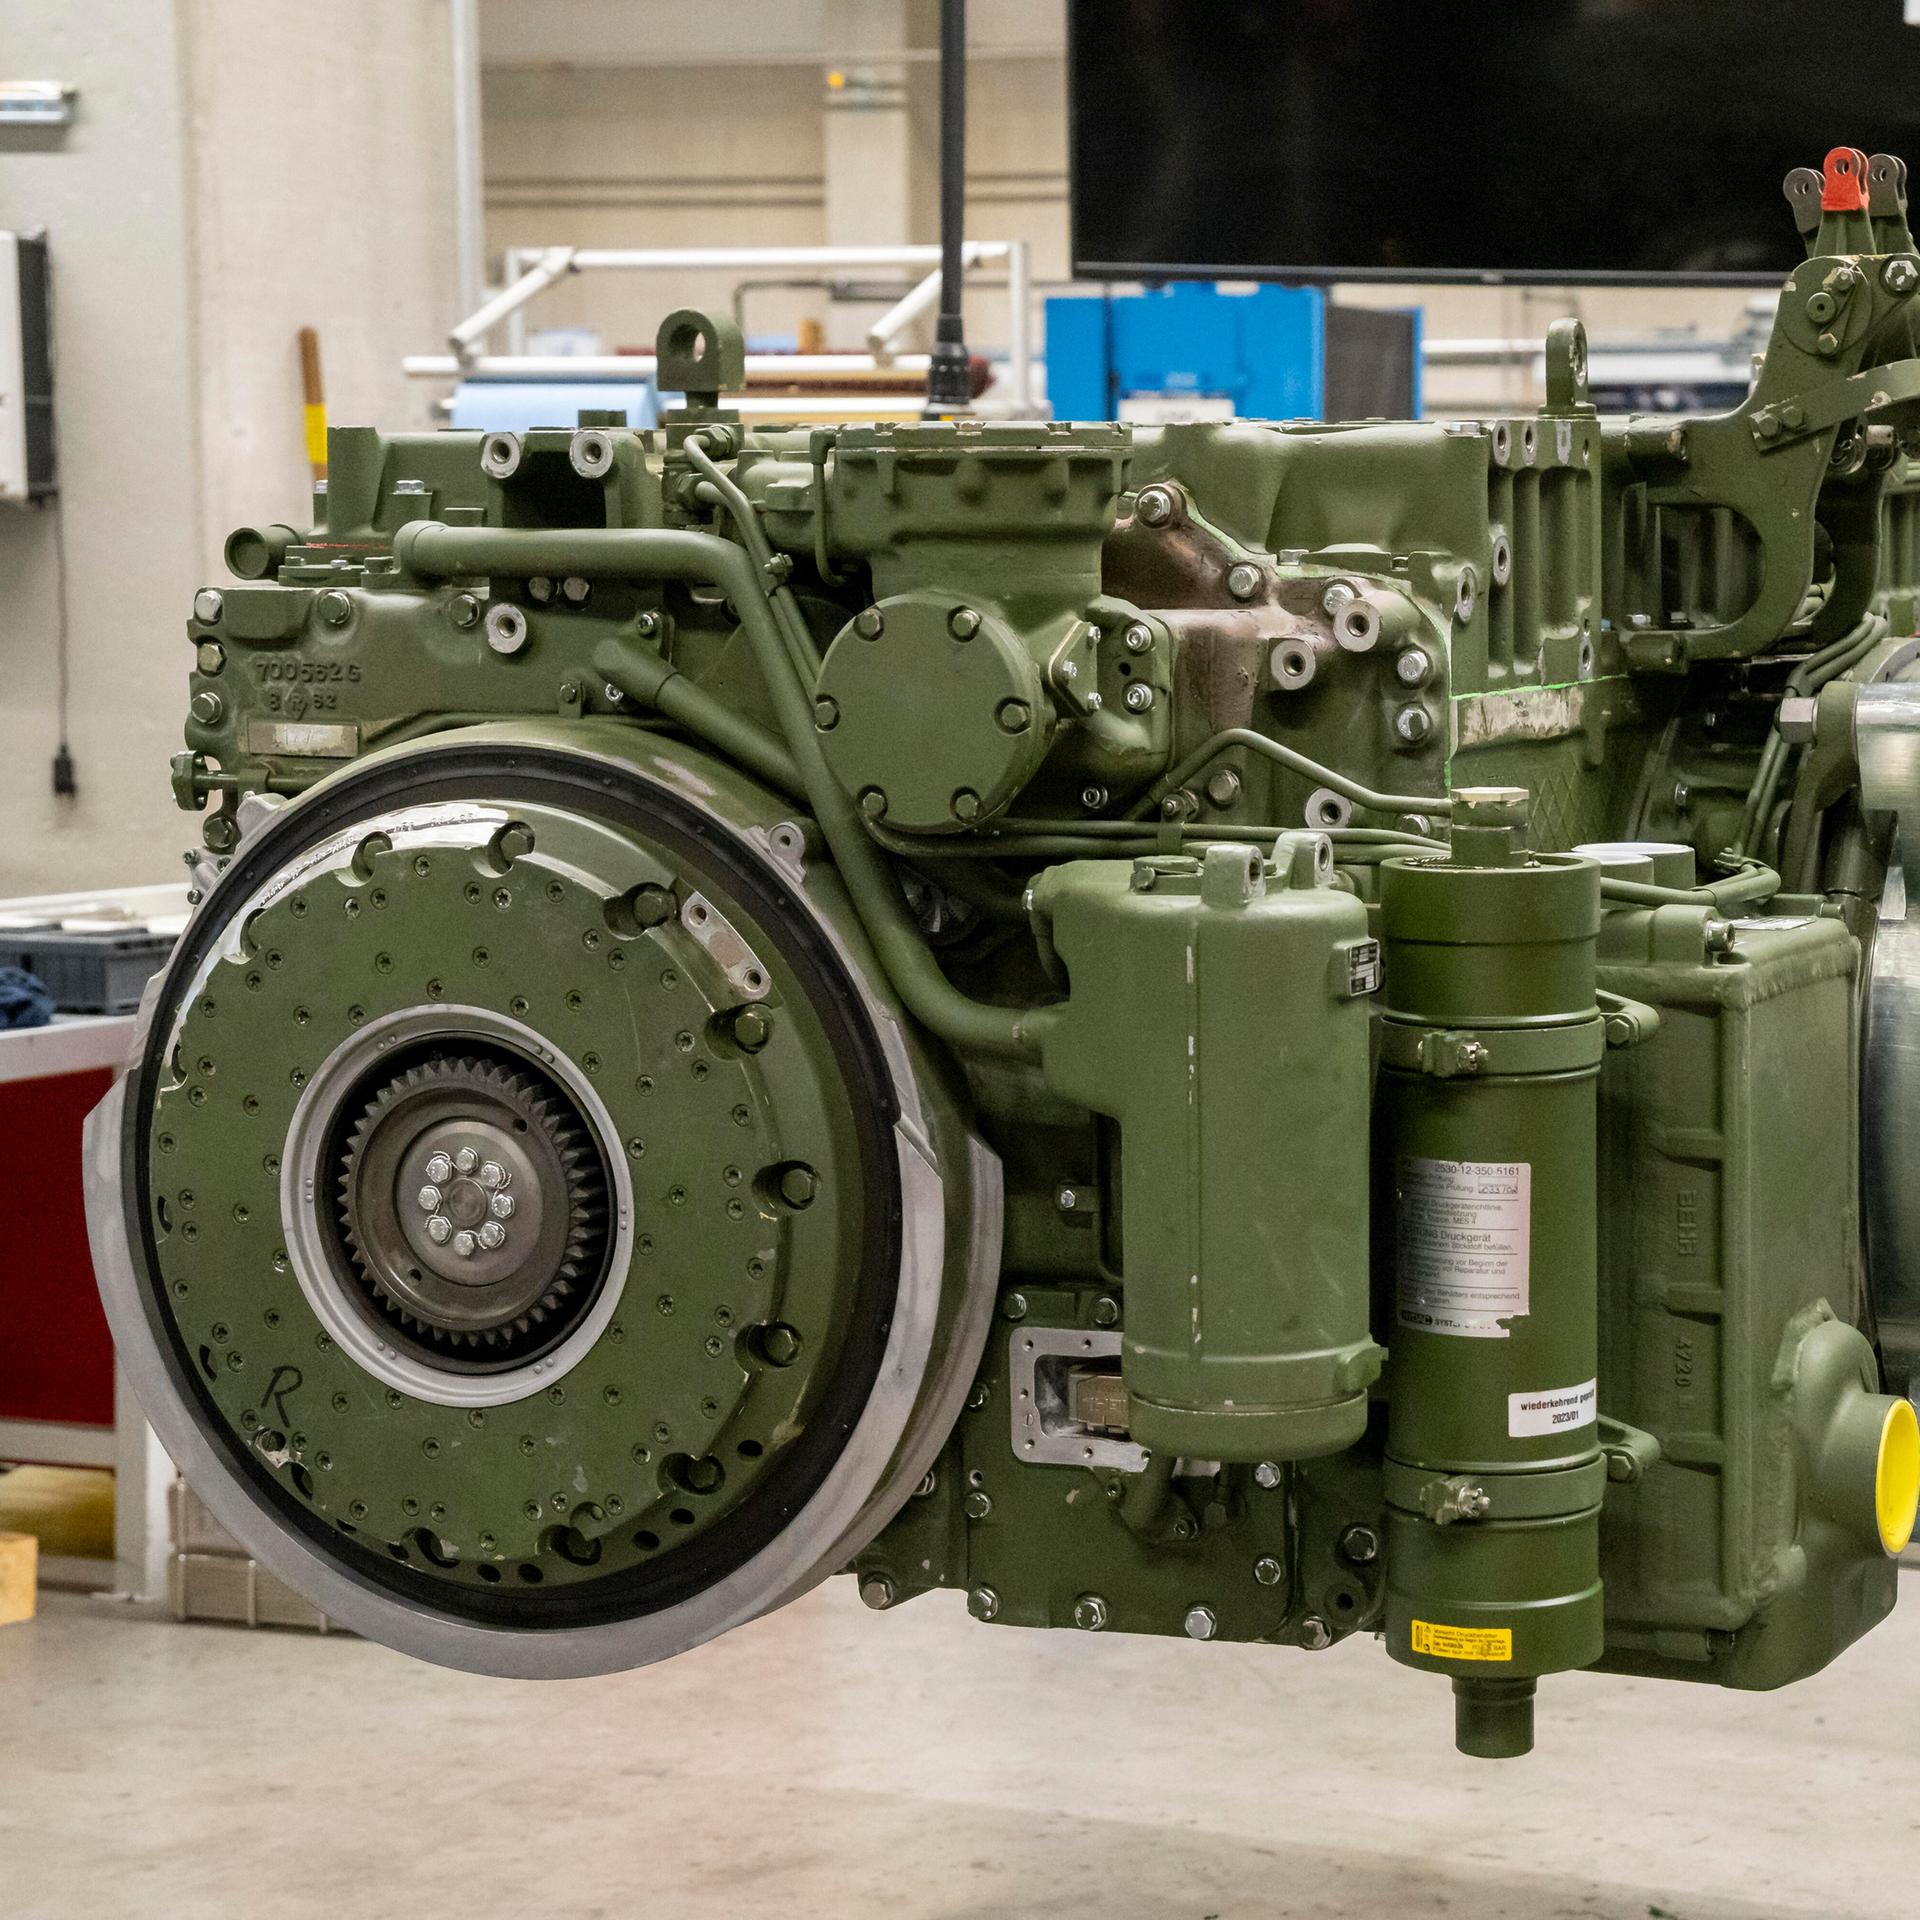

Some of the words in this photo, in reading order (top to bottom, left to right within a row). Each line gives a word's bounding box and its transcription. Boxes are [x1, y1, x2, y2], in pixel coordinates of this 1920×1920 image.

[1441, 1230, 1491, 1242] Druckgerät
[261, 1366, 303, 1428] R
[1521, 1395, 1579, 1411] wiederkehrend
[1552, 1410, 1579, 1425] 2023/01
